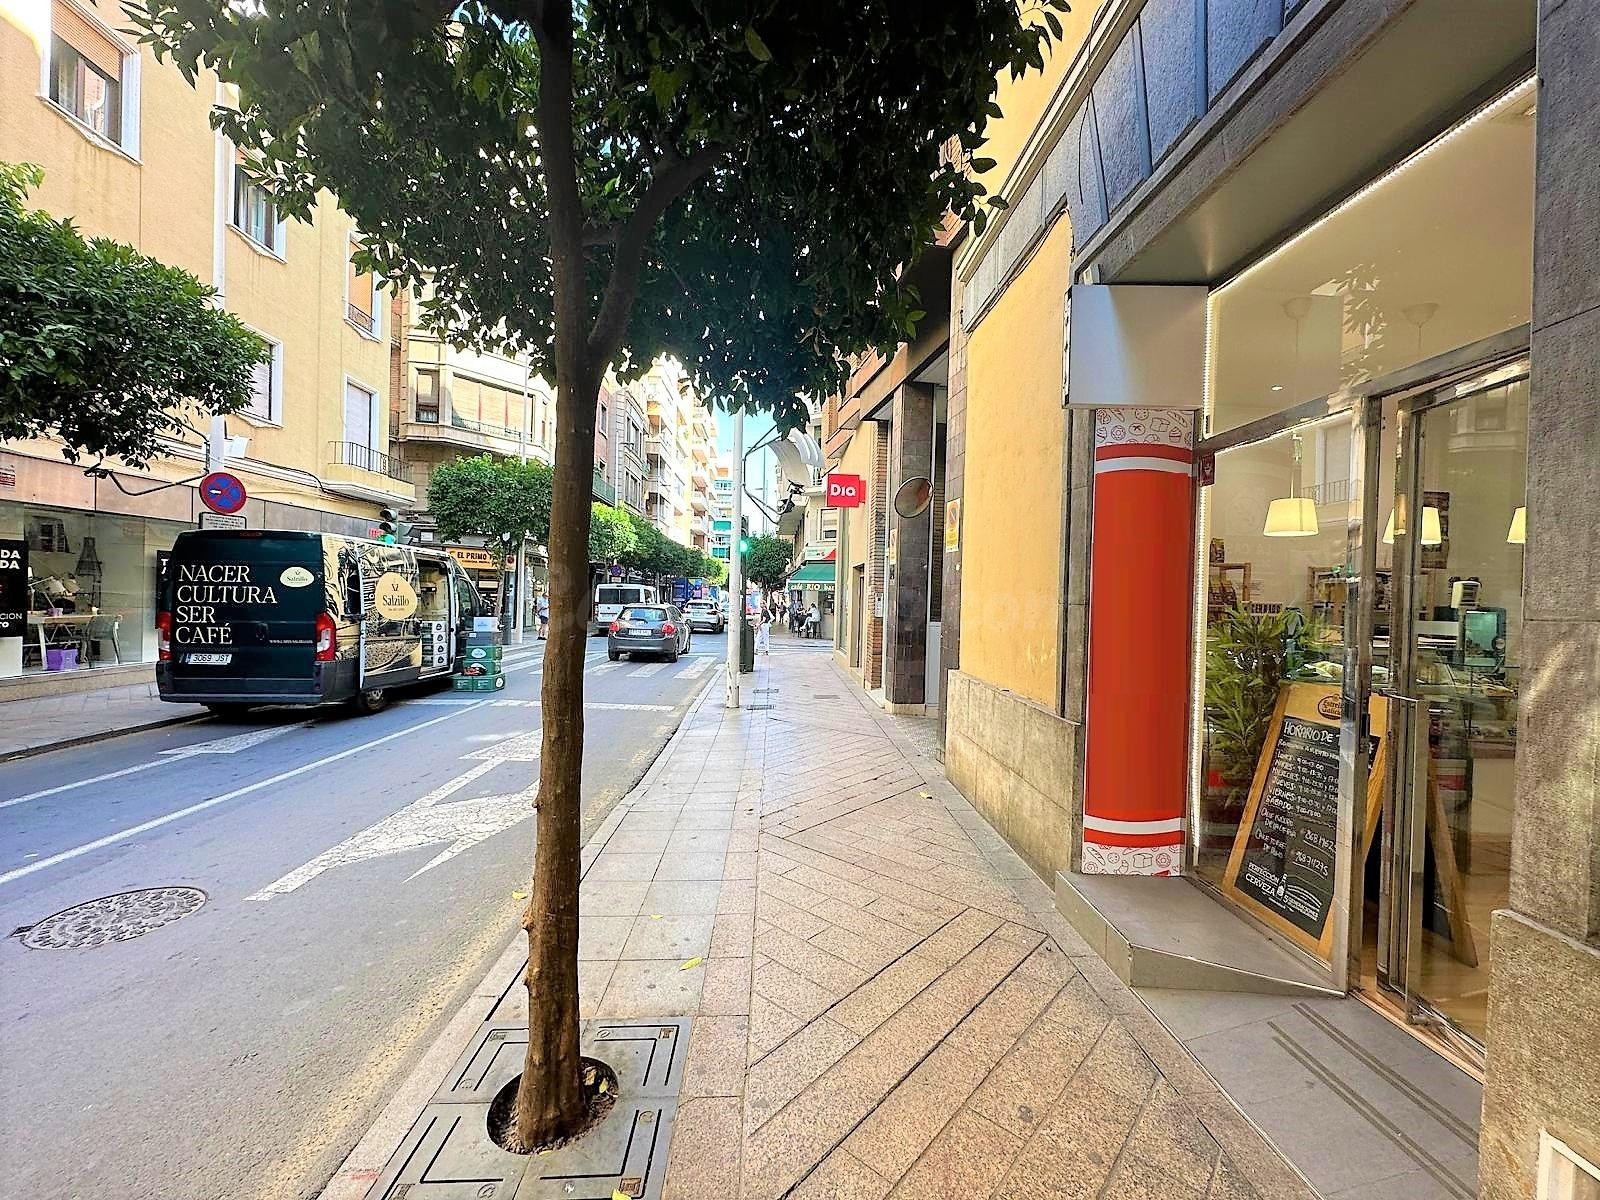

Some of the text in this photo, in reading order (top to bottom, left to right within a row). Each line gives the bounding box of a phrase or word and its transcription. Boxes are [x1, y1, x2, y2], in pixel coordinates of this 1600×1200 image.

[466, 552, 487, 560] PRIMO
[179, 565, 250, 583] NACER
[177, 585, 278, 604] CULTURA
[382, 594, 410, 606] Salzillo
[176, 606, 216, 624] SER
[176, 622, 233, 645] CAFÉ
[1284, 721, 1320, 740] HORARIO
[1320, 730, 1333, 742] DE
[1245, 873, 1274, 895] CERVEZA
